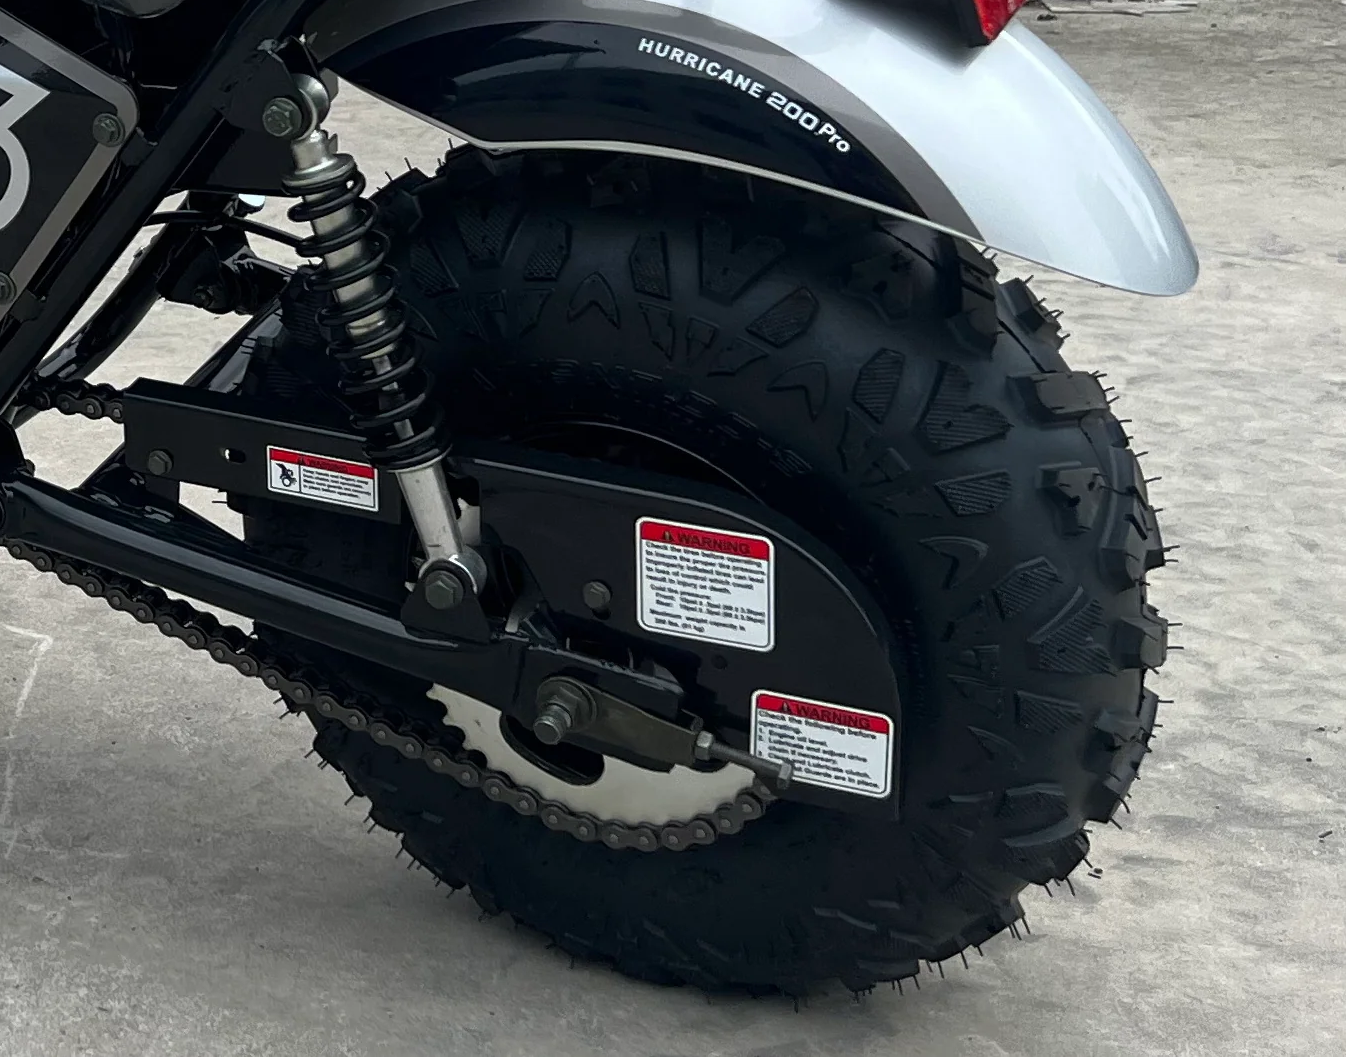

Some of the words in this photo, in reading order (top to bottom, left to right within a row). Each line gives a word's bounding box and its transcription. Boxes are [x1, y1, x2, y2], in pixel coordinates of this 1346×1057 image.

[638, 37, 766, 99] HURRICANE
[678, 532, 749, 554] WARNING
[797, 704, 870, 729] WARNING
